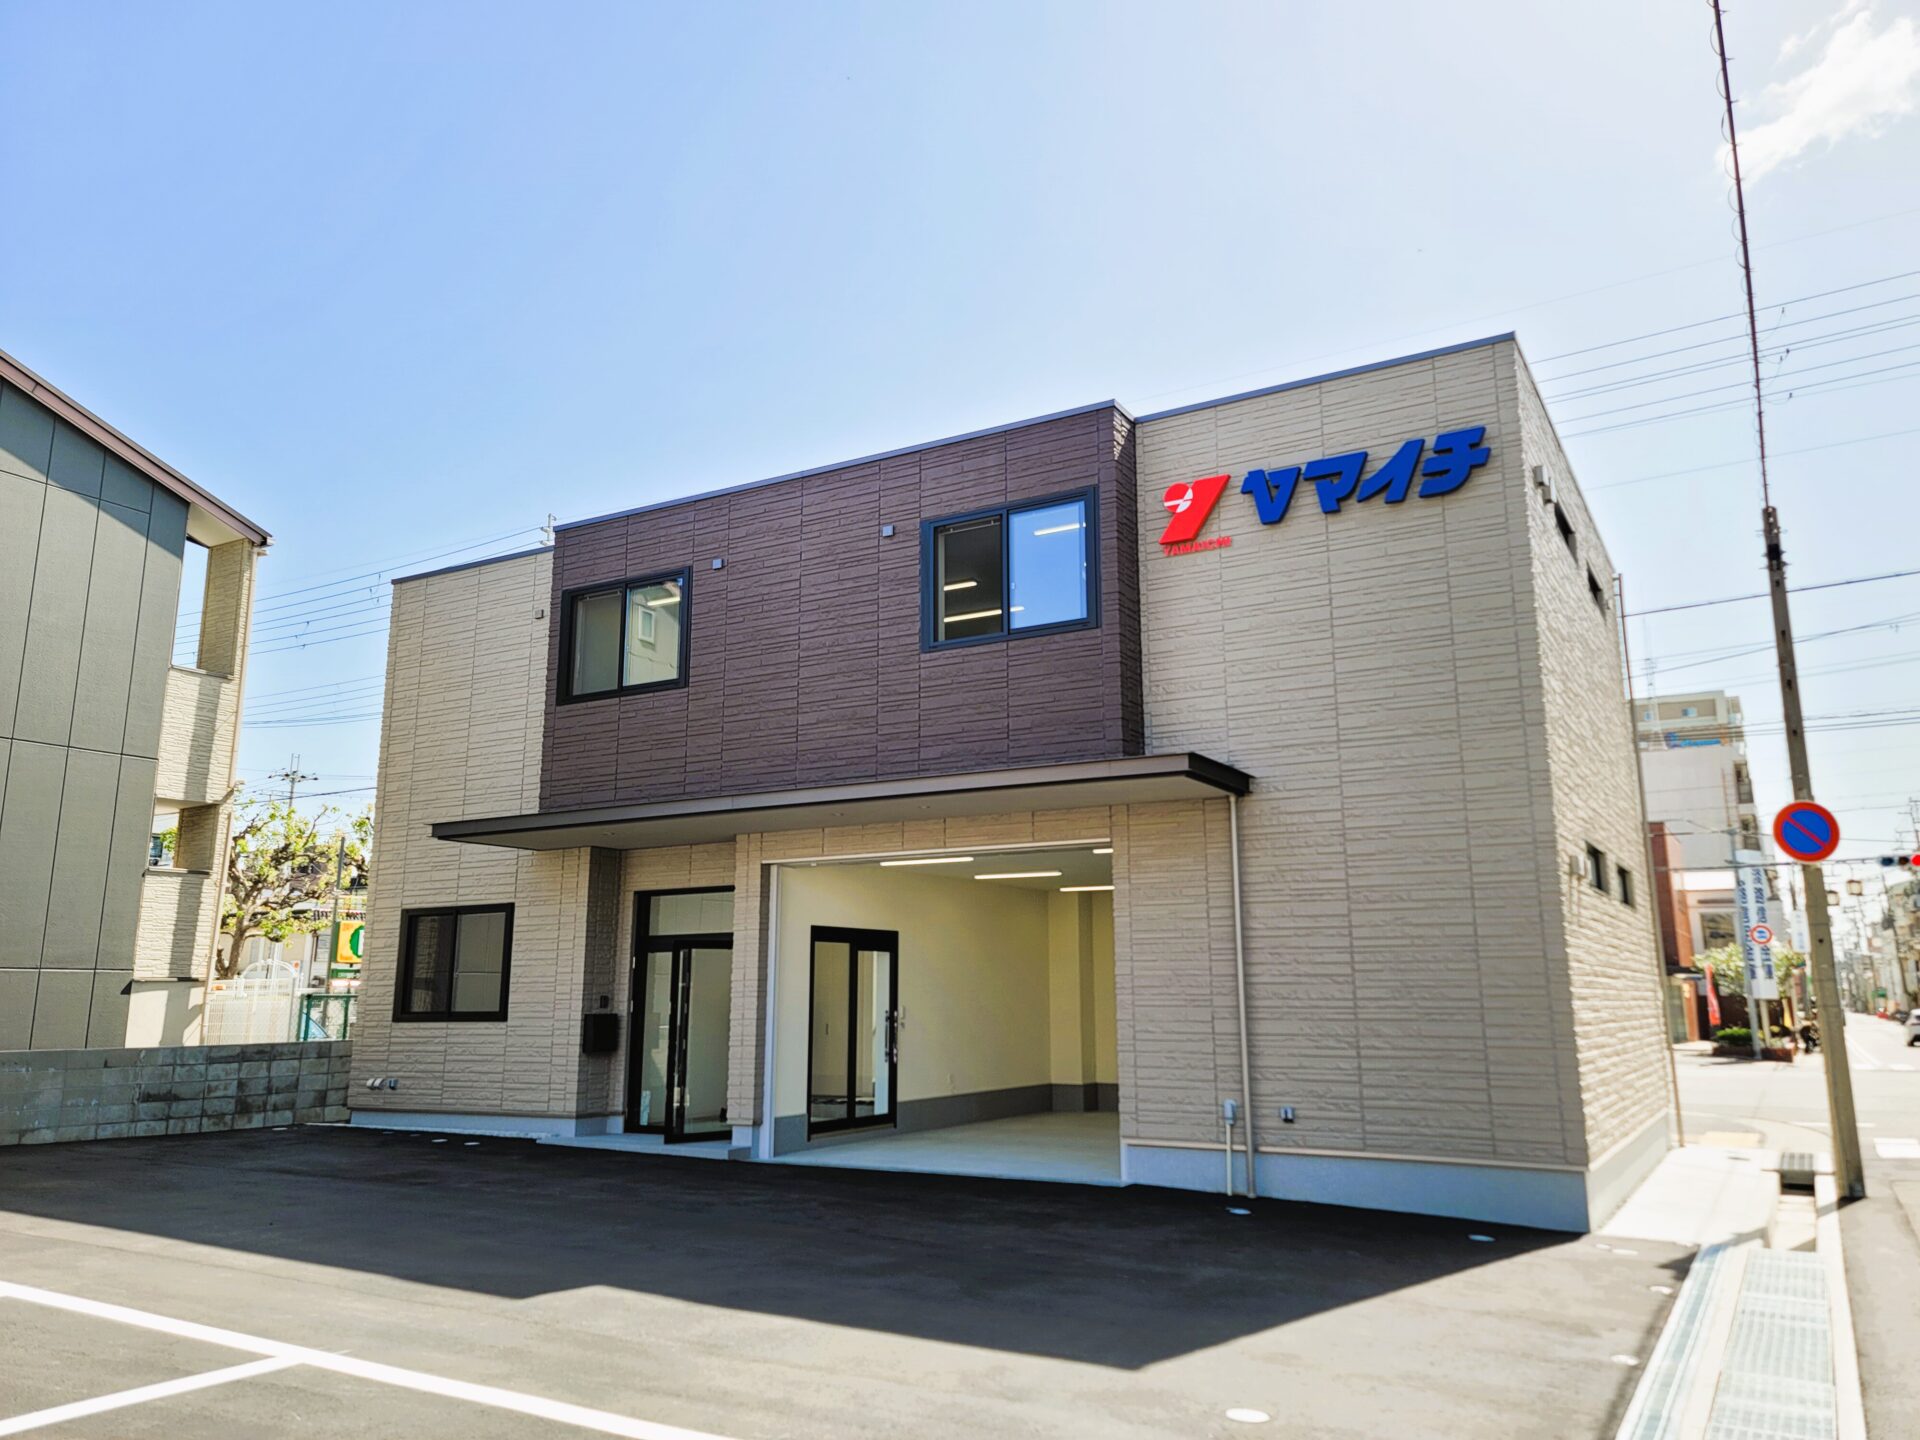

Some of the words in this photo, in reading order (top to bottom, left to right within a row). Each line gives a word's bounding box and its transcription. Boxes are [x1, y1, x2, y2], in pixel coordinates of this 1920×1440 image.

[1240, 424, 1492, 525] ヤマイチ
[1163, 536, 1232, 557] YAMAICHI
